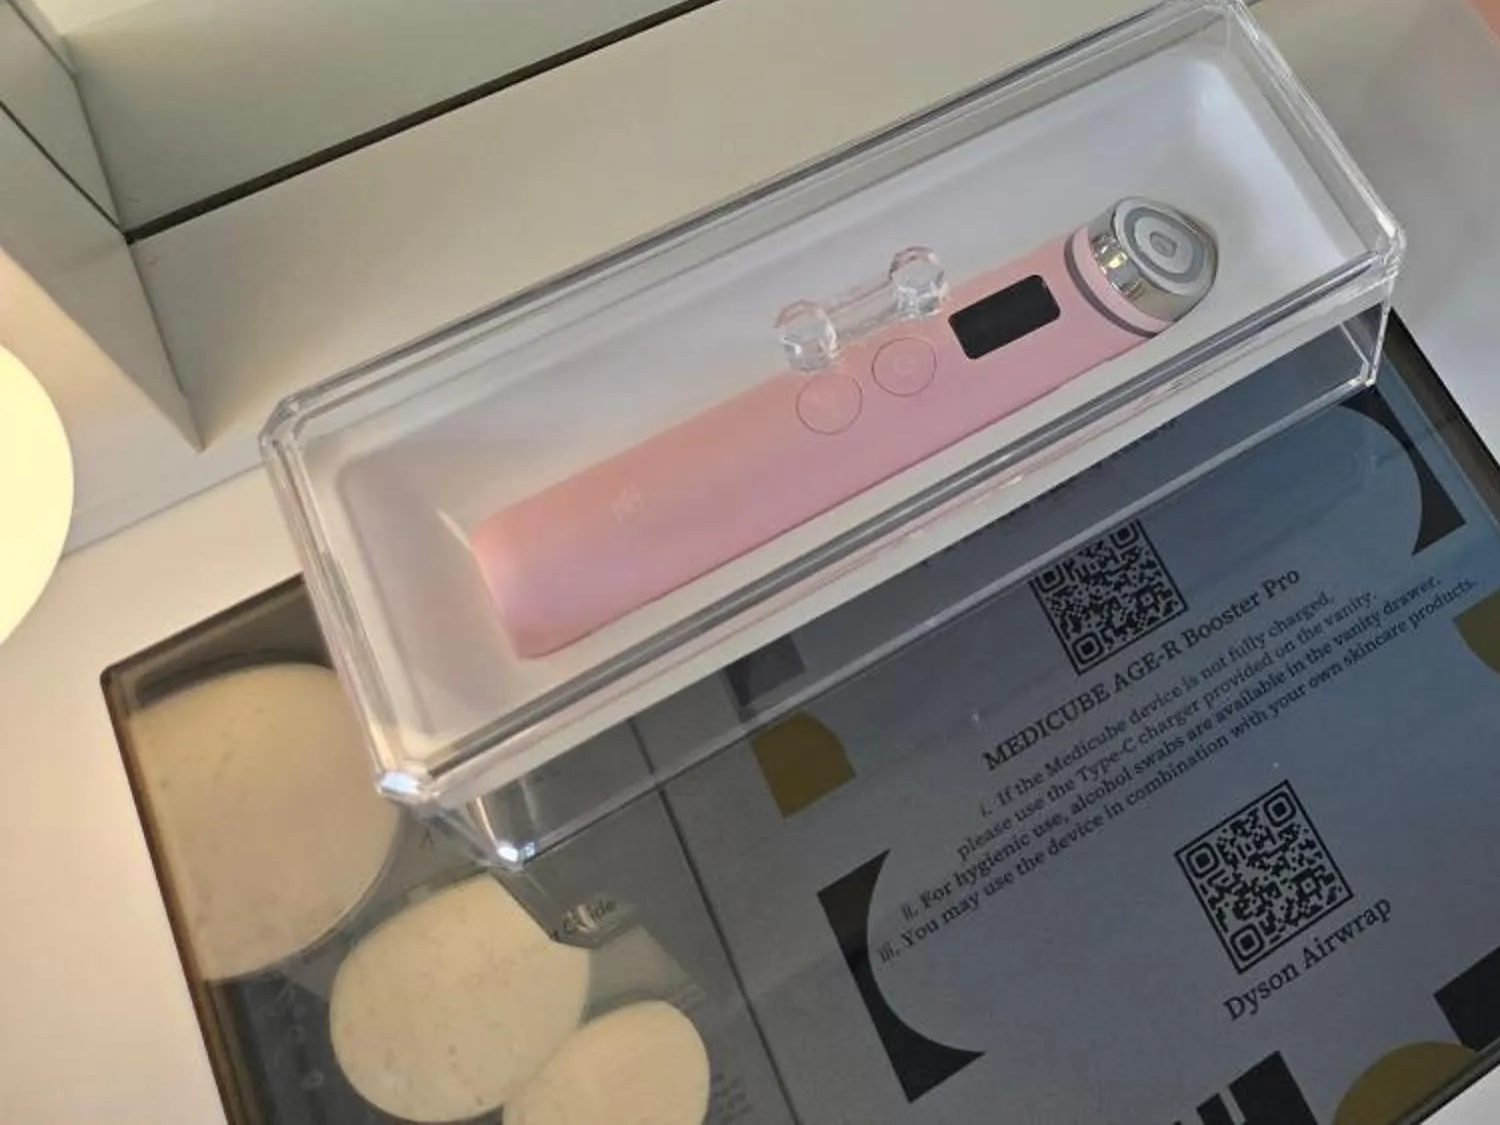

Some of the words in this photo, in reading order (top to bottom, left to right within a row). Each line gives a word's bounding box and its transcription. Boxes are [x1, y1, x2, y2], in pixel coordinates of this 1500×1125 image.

[901, 918, 939, 947] You
[941, 891, 980, 923] may
[982, 872, 1015, 897] use
[1016, 850, 1047, 876] the
[1048, 815, 1104, 856] device
[1104, 799, 1125, 819] in
[1126, 734, 1230, 805] combination
[1230, 707, 1269, 738] with
[1268, 684, 1306, 718] your
[1308, 664, 1343, 689] own
[1343, 620, 1407, 667] skincare
[919, 881, 952, 909] For
[953, 831, 1032, 886] hygienic
[1031, 811, 1070, 839] use,
[1071, 766, 1133, 815] alcohol
[1133, 736, 1185, 774] swabs
[1186, 717, 1213, 742] are
[1215, 670, 1286, 724] available
[1287, 657, 1306, 677] in
[1306, 641, 1333, 666] the
[1333, 610, 1382, 647] vanity
[1382, 575, 1442, 615] drawer.
[957, 818, 1012, 861] please
[1014, 797, 1045, 822] use
[1047, 777, 1076, 802] the
[1076, 737, 1137, 782] Type-C
[1138, 698, 1200, 745] charger
[1203, 651, 1274, 709] provided
[1275, 640, 1296, 659] on
[1296, 623, 1322, 645] the
[1324, 591, 1377, 627] vanity.
[982, 682, 1111, 771] MEDICUBE
[1113, 639, 1183, 693] AGE-R
[1181, 591, 1261, 648] Booster
[1261, 569, 1301, 599] Pro
[997, 784, 1014, 806] If
[1015, 771, 1044, 795] the
[1045, 720, 1127, 775] Medicube
[1128, 685, 1182, 725] device
[1183, 675, 1200, 691] is
[1201, 656, 1228, 680] not
[1228, 632, 1266, 662] fully
[1222, 962, 1300, 1021] Dyson
[1302, 898, 1392, 970] Airwrap
